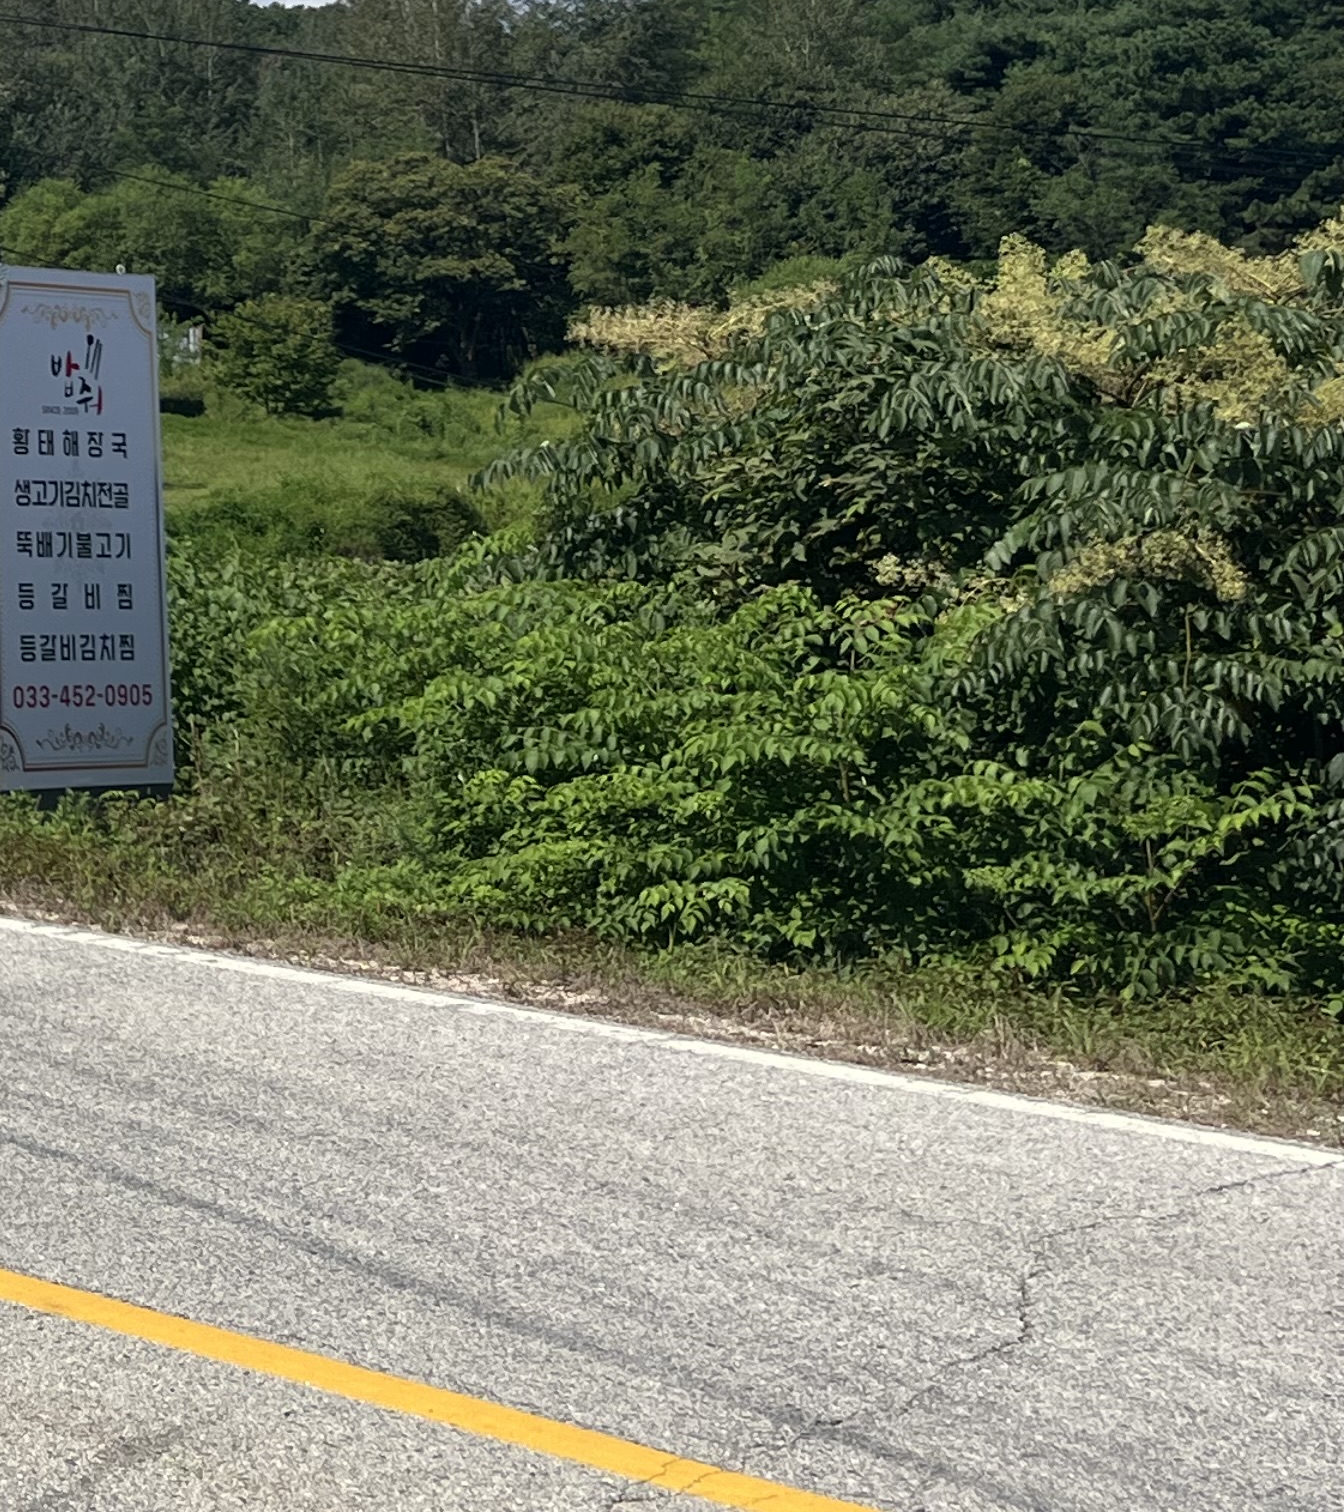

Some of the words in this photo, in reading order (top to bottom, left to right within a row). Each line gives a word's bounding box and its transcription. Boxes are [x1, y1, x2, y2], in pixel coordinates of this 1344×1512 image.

[12, 427, 128, 459] 황태해장국
[14, 479, 129, 509] 생고기김치전골
[16, 530, 131, 559] 뚝배기불고기
[20, 633, 135, 662] 등갈비김치찜
[13, 683, 153, 709] 033-452-0905
